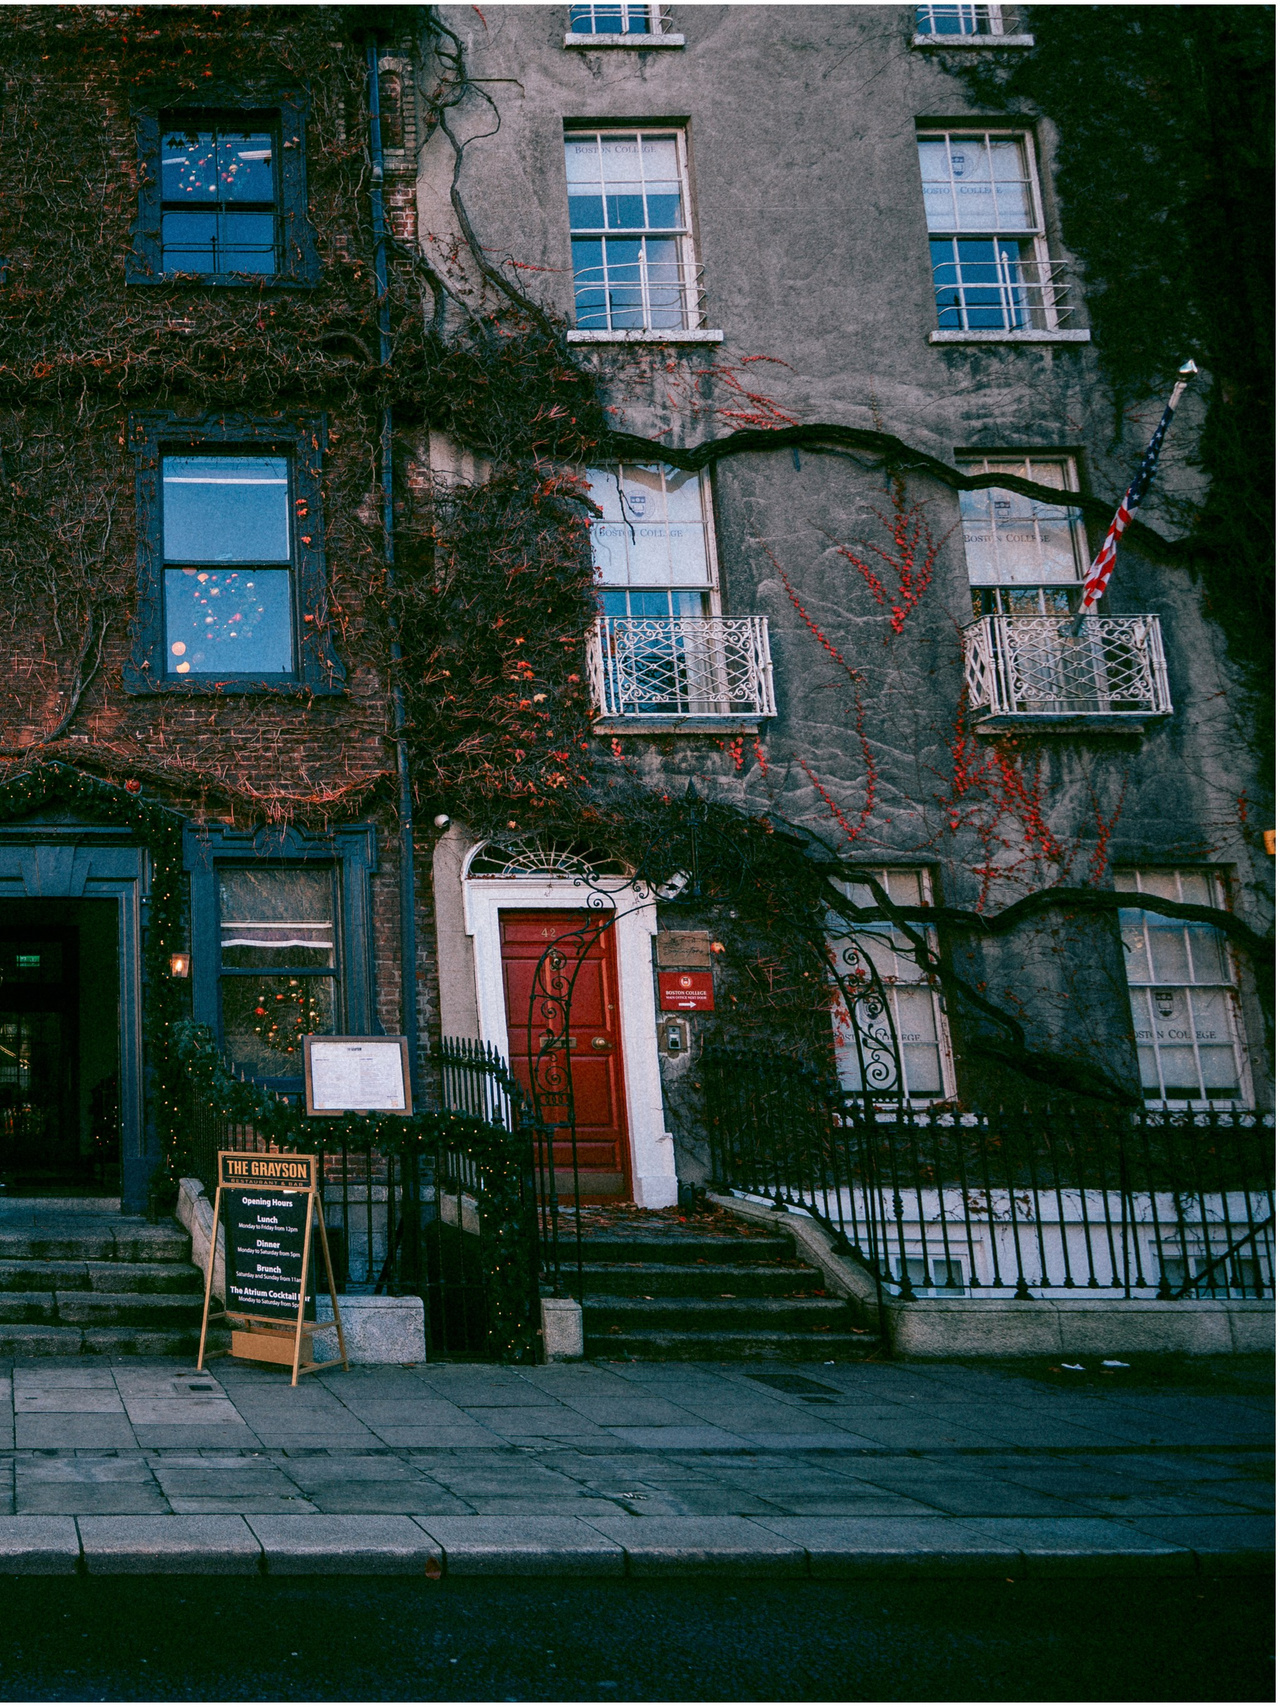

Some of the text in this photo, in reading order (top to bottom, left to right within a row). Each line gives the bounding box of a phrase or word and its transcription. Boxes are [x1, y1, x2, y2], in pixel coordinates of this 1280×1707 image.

[922, 186, 1003, 195] BOSTO COLLEE
[541, 927, 556, 938] 42
[1168, 1029, 1217, 1039] COLEGE
[226, 1160, 307, 1179] THE GRAYSON
[230, 1178, 277, 1186] RESTAURANT
[242, 1196, 293, 1208] Opening Hours
[257, 1215, 278, 1224] Lunch
[238, 1222, 256, 1230] Monday
[256, 1239, 280, 1249] Dinner
[237, 1246, 255, 1254] Monday
[260, 1248, 279, 1257] Saturday
[256, 1264, 282, 1274] Brunch
[236, 1270, 254, 1279] Saturday
[263, 1274, 280, 1282] Sunday
[230, 1285, 243, 1294] The
[244, 1287, 268, 1297] Atrium
[268, 1290, 297, 1301] Cocktail
[238, 1296, 256, 1304] Monday
[261, 1298, 280, 1306] Saturday
[291, 1301, 300, 1309] 5p
